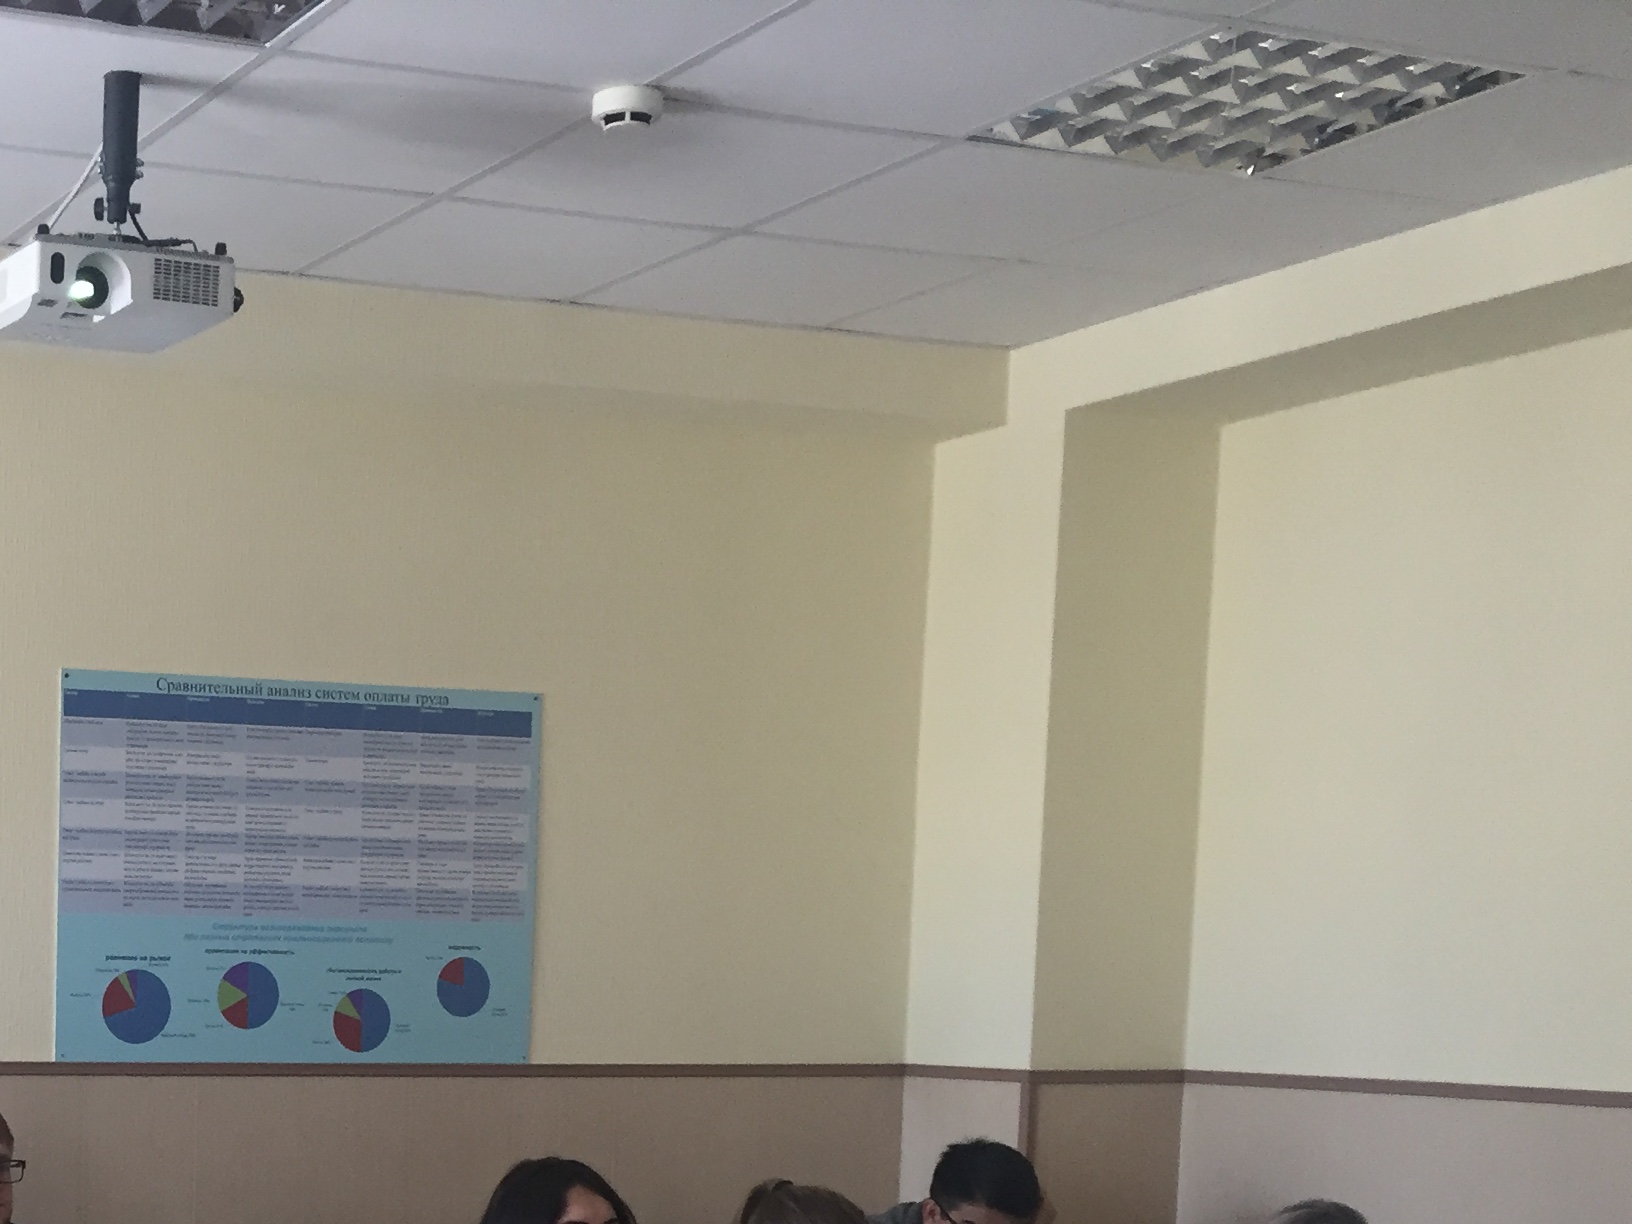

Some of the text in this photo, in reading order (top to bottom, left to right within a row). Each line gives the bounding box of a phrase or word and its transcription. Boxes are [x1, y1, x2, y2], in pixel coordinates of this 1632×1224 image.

[156, 677, 450, 708] Сравнительный анализ систем оплаты труда
